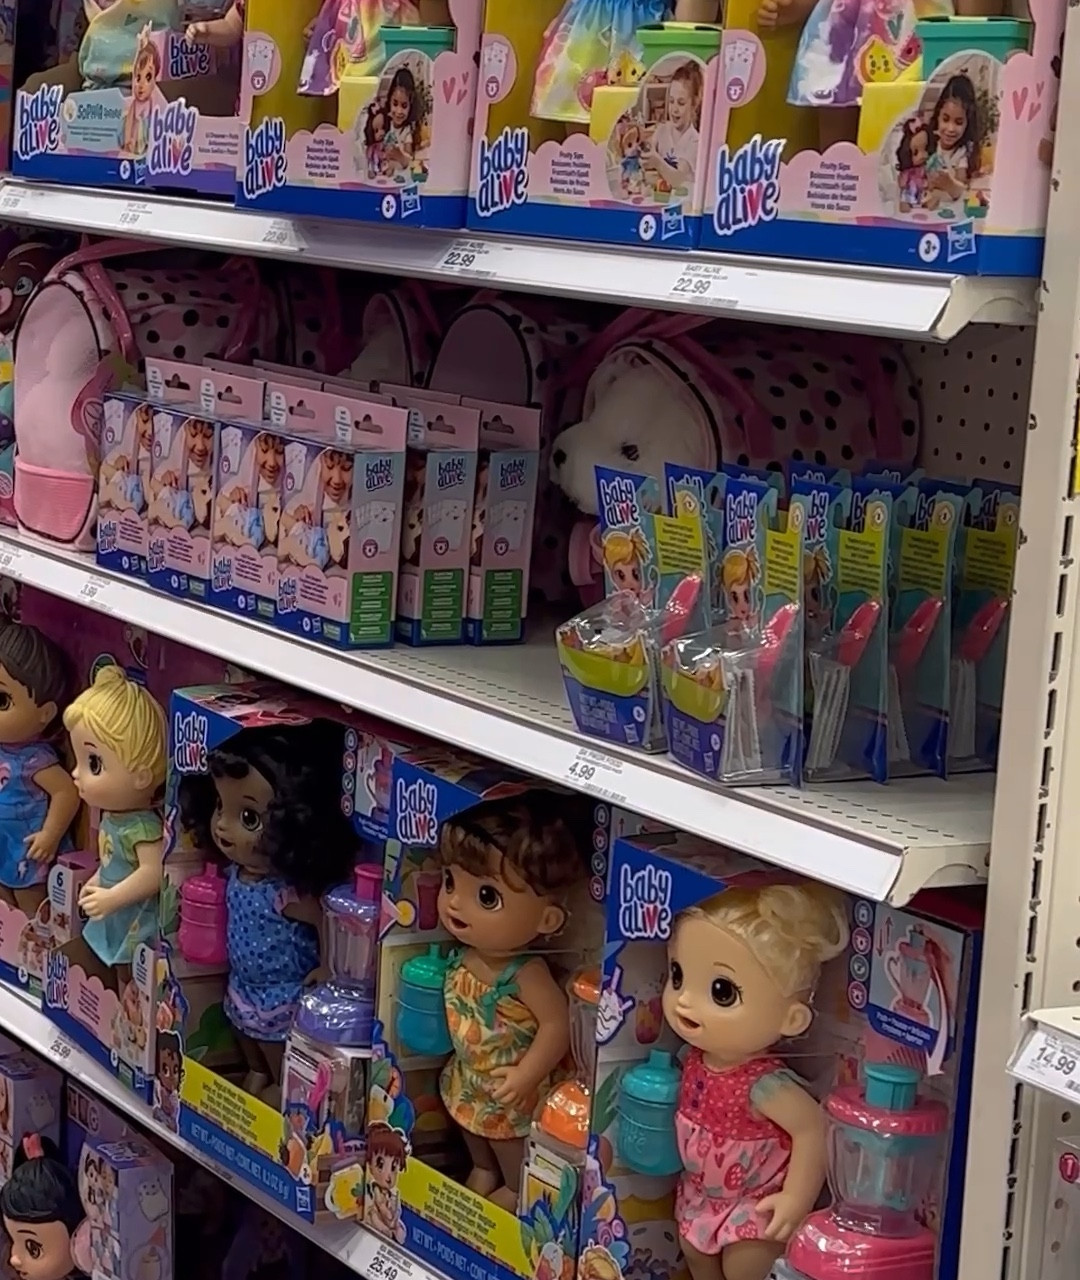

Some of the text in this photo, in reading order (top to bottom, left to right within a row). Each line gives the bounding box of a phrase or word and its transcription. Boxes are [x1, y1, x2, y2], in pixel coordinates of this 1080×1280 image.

[19, 84, 62, 125] baby
[153, 100, 198, 143] baby
[19, 117, 61, 159] alive
[150, 136, 193, 174] alive
[245, 119, 286, 166] baby
[480, 128, 528, 182] baby
[244, 156, 287, 197] alive
[719, 134, 781, 194] baby
[478, 168, 528, 214] alive
[718, 182, 778, 232] alive
[443, 252, 476, 267] 22.99
[924, 239, 937, 255] 3+
[671, 277, 712, 295] 22.99
[365, 457, 392, 478] baby
[437, 457, 464, 476] baby
[600, 478, 635, 512] baby
[726, 491, 757, 524] baby
[606, 502, 640, 528] alive
[726, 519, 757, 544] alive
[174, 711, 209, 746] baby
[174, 740, 209, 772] alive
[568, 762, 597, 781] 4.99
[396, 778, 438, 817] baby
[396, 811, 439, 844] alive
[56, 871, 64, 887] 6
[620, 864, 673, 907] baby
[620, 900, 672, 939] alive
[1034, 1046, 1076, 1076] 14.99
